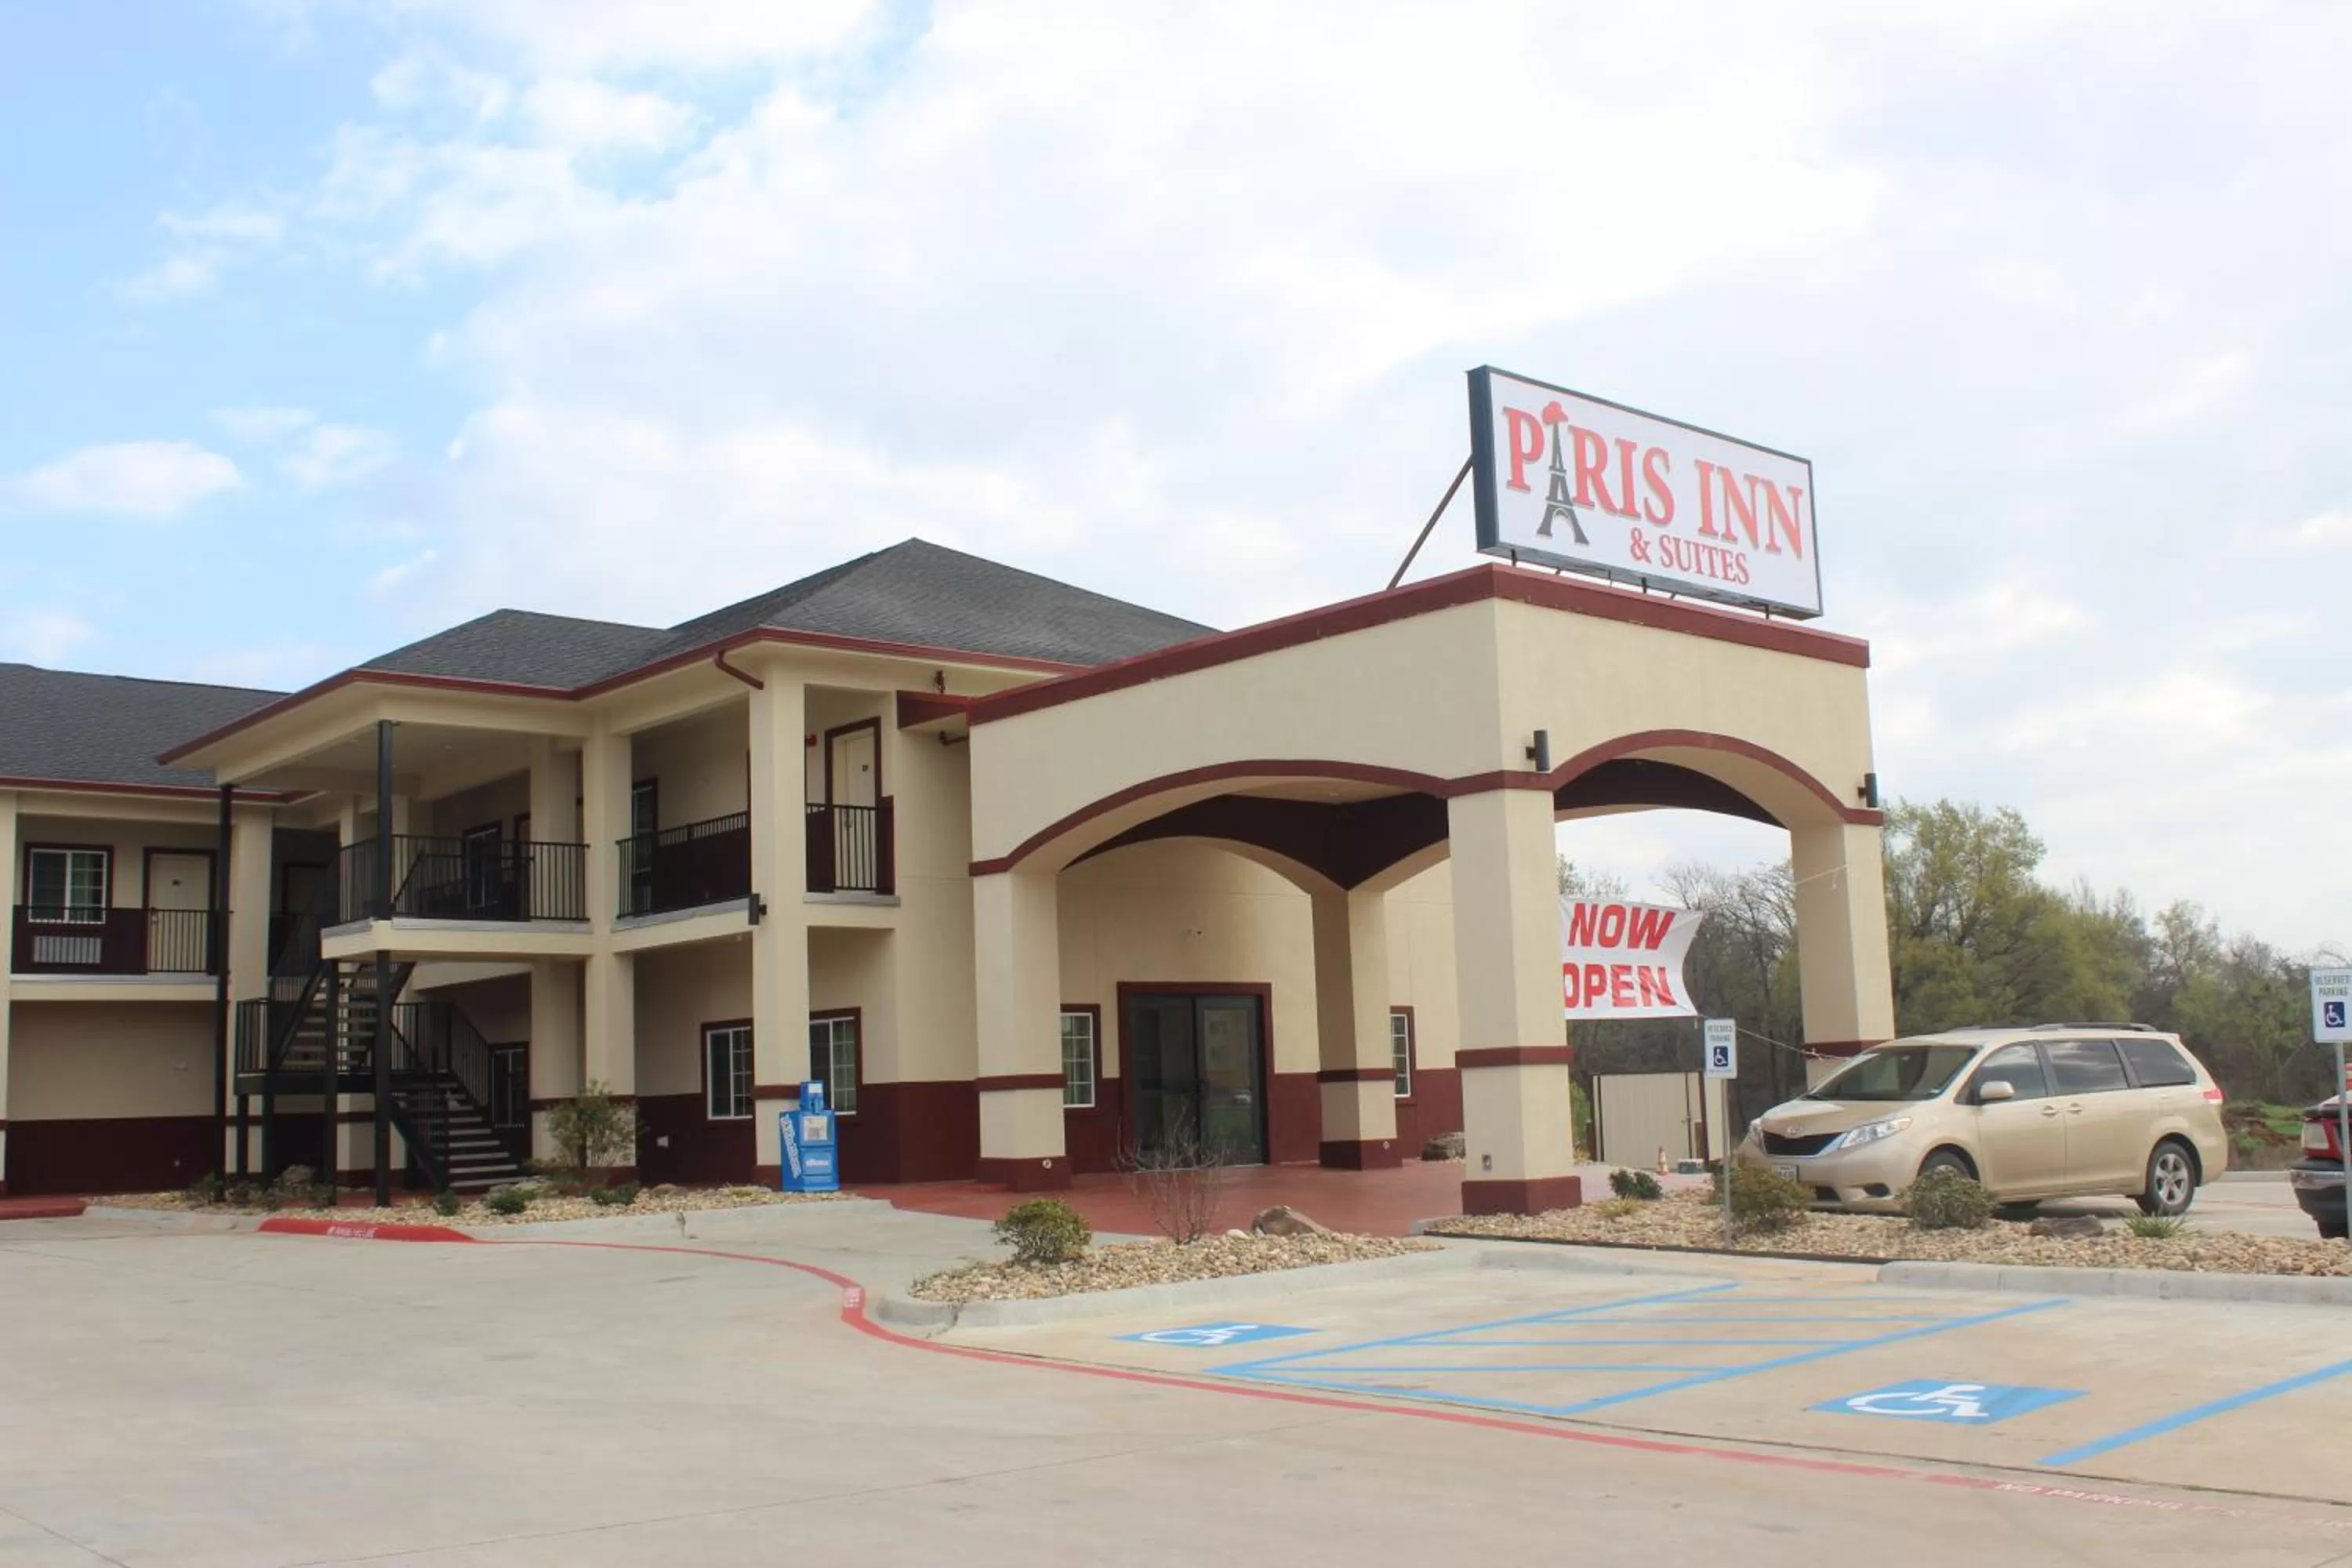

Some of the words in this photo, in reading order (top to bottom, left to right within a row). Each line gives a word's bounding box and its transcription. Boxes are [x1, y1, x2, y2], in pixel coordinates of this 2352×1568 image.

[1502, 401, 1675, 544] PARIS
[1694, 459, 1803, 560] INN
[1629, 526, 1651, 564] &
[1659, 534, 1750, 586] SUITES
[1568, 902, 1678, 951] NOW
[1562, 962, 1678, 1009] OPEN
